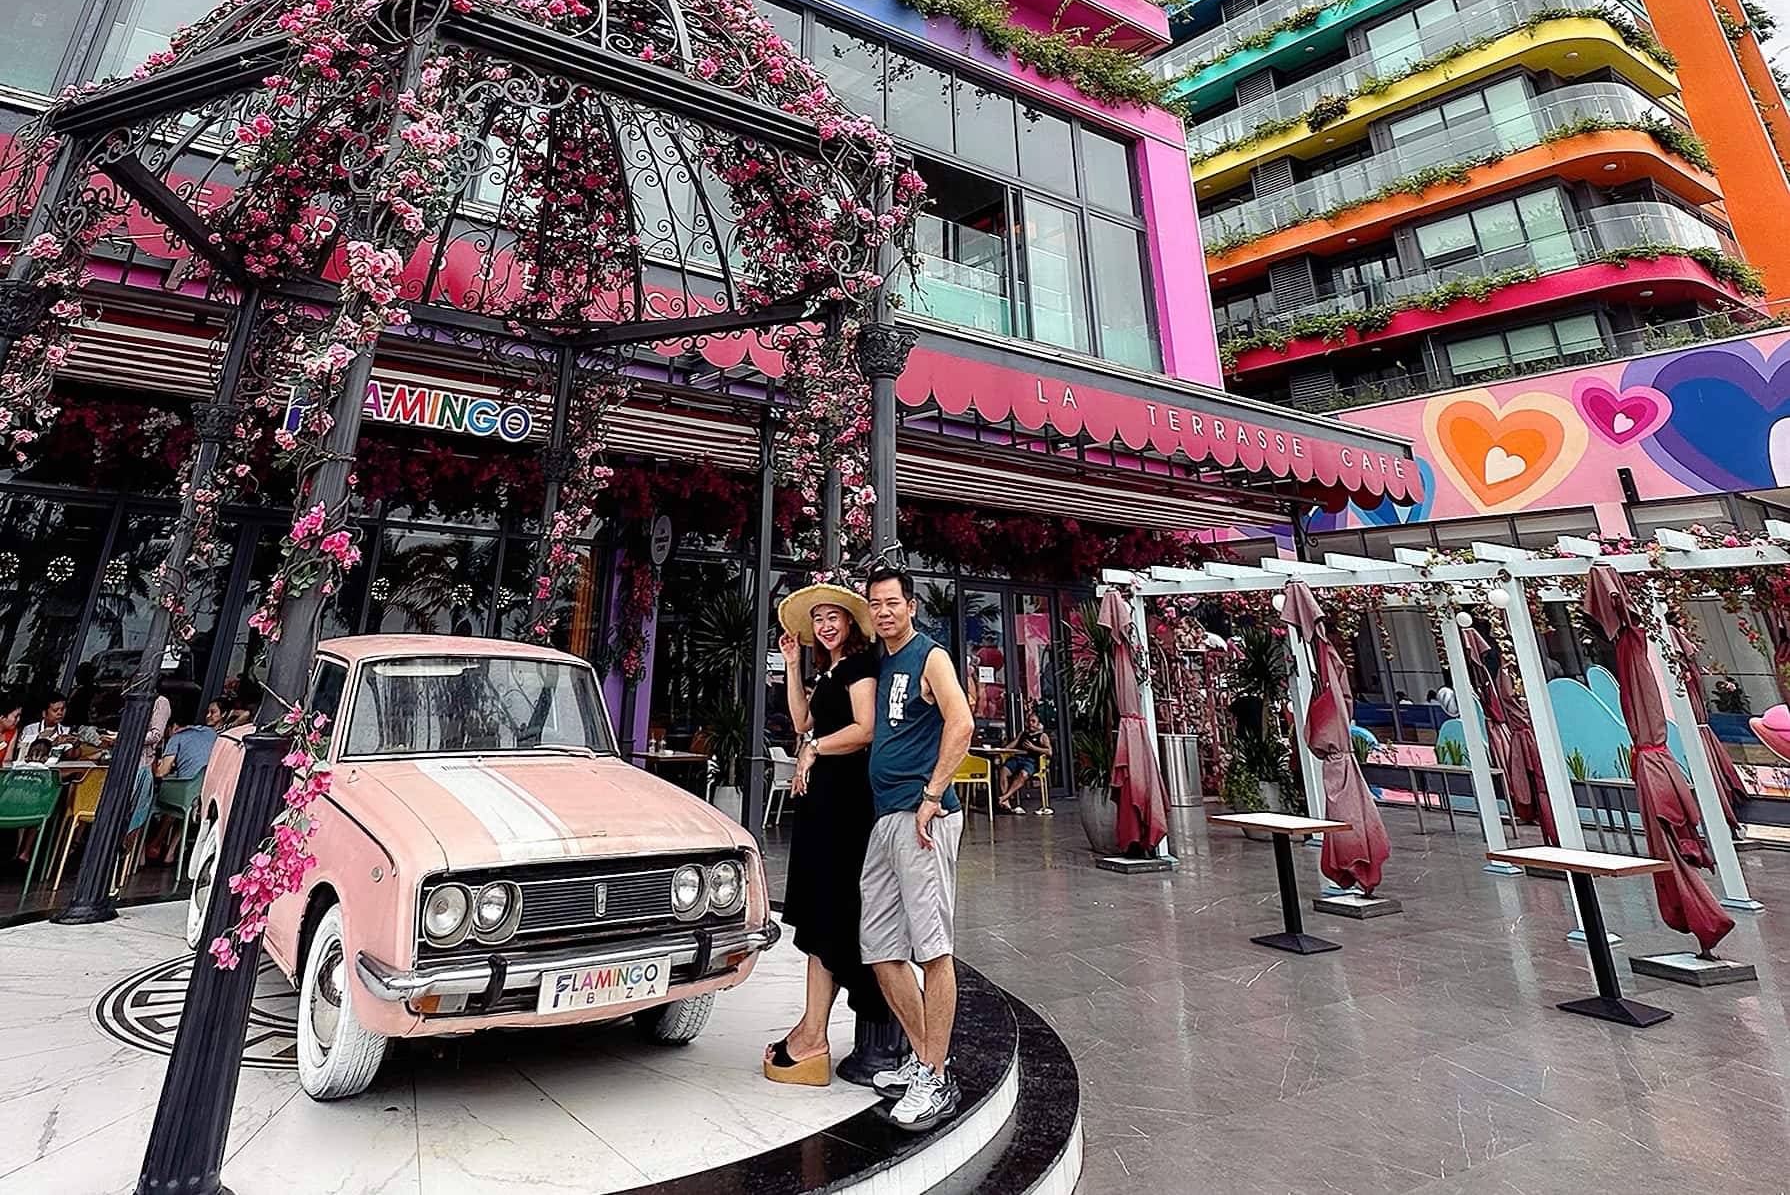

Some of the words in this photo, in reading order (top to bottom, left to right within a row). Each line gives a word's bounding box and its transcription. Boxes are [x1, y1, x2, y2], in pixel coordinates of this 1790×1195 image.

[283, 379, 533, 442] AMINGO
[1036, 379, 1078, 410] LA
[1146, 404, 1304, 458] TERRASSE
[552, 963, 658, 1009] FLAMINGO
[568, 984, 657, 1006] IBIZA
